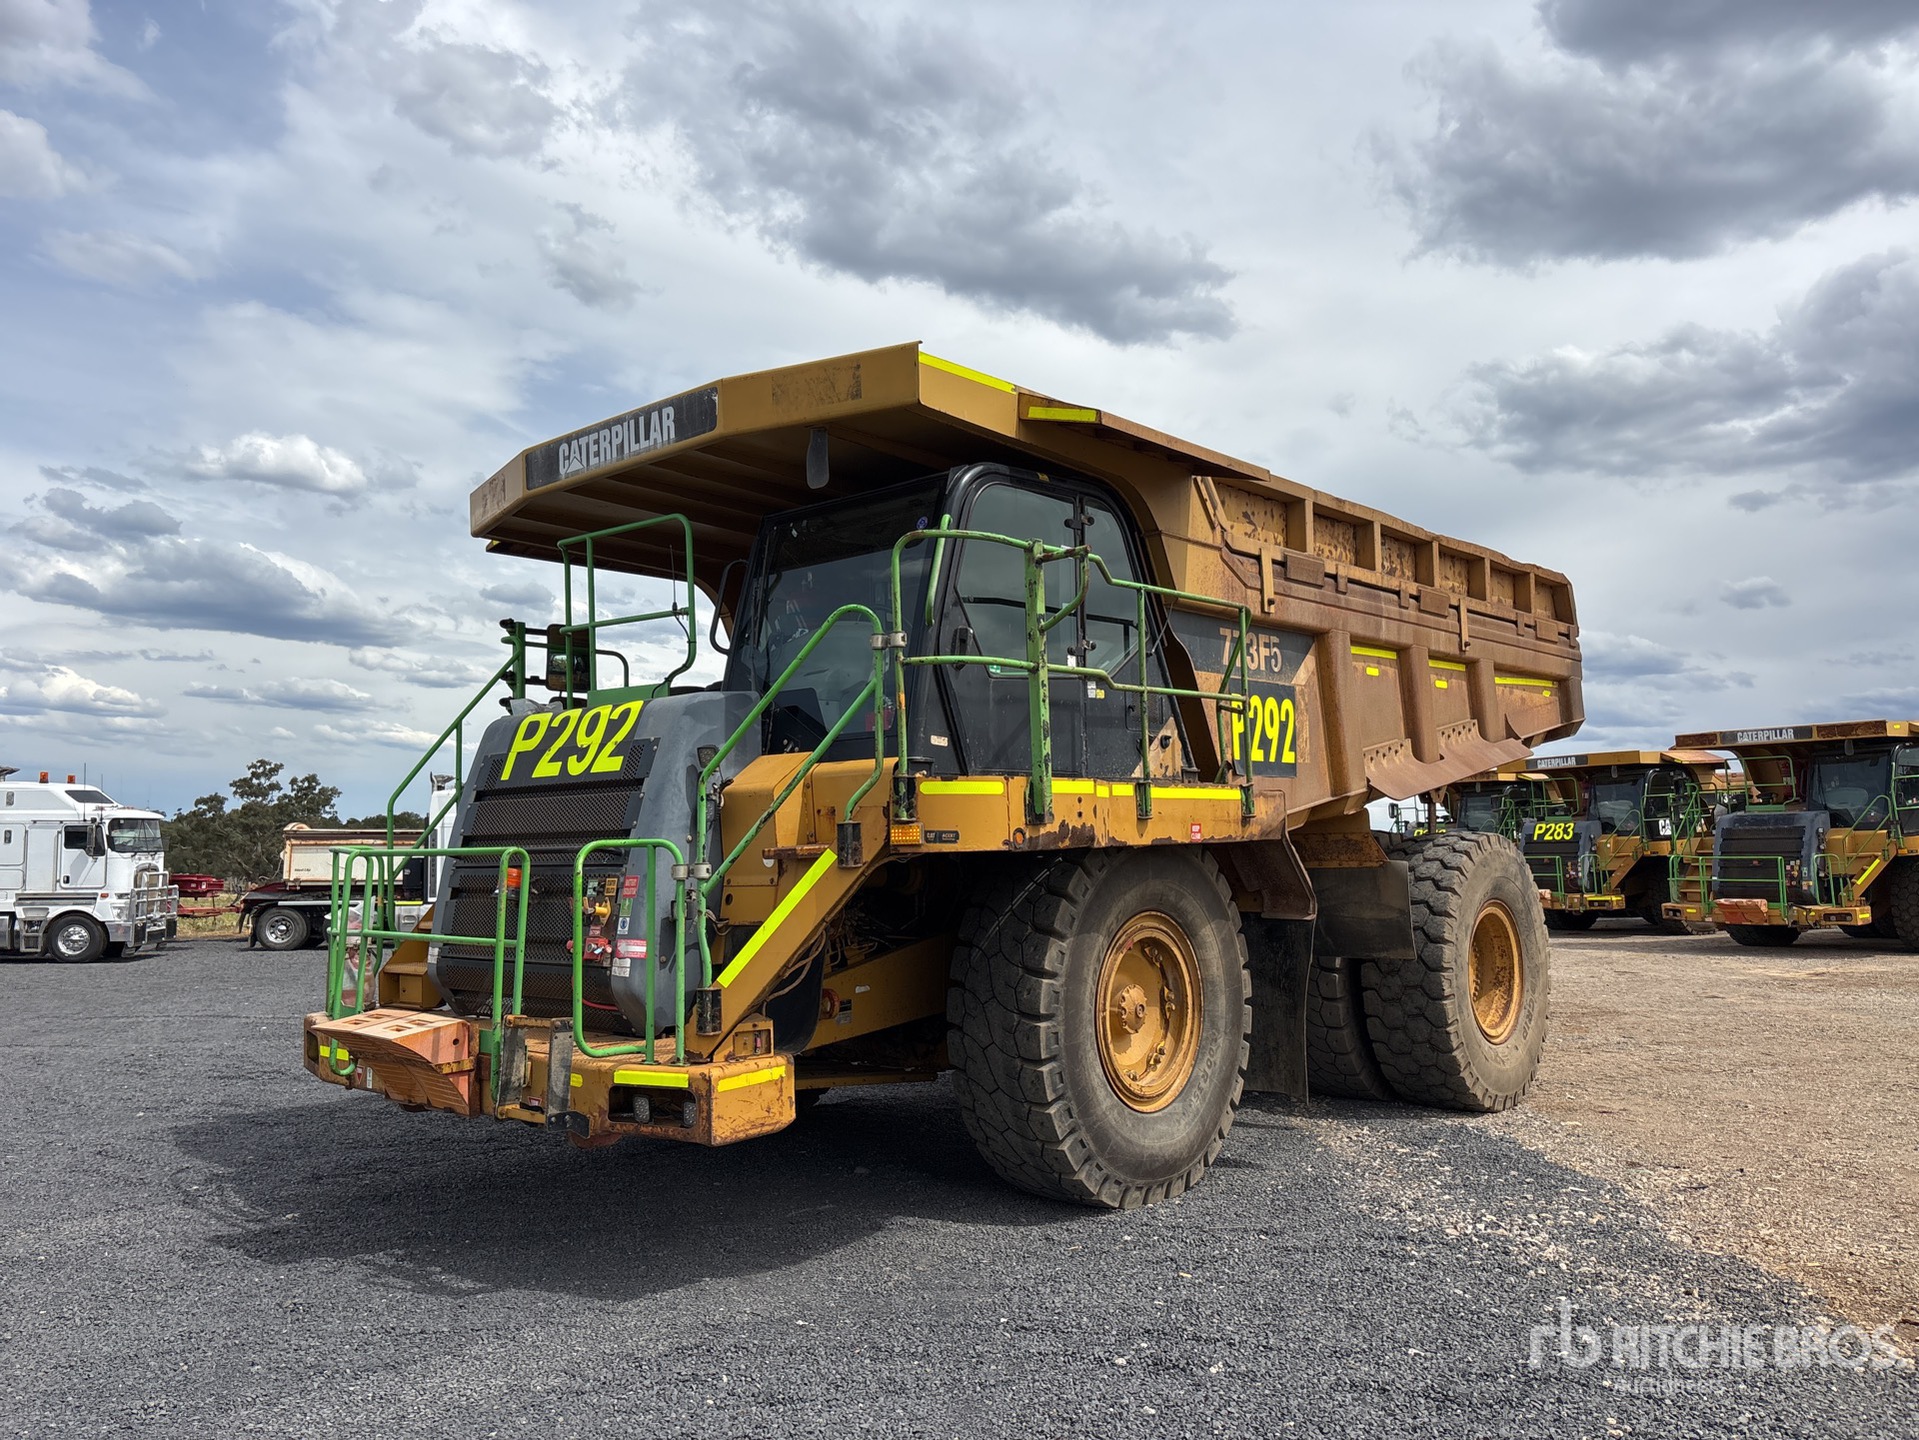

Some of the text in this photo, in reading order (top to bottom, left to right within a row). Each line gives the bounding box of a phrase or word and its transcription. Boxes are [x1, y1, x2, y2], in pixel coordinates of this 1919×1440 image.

[558, 406, 676, 477] CATERPILLAR
[501, 700, 644, 781] P292
[1231, 693, 1296, 764] P292
[1737, 729, 1795, 743] CATERPILLAR
[1537, 757, 1576, 769] CATERPILLAR
[1534, 822, 1575, 841] P283
